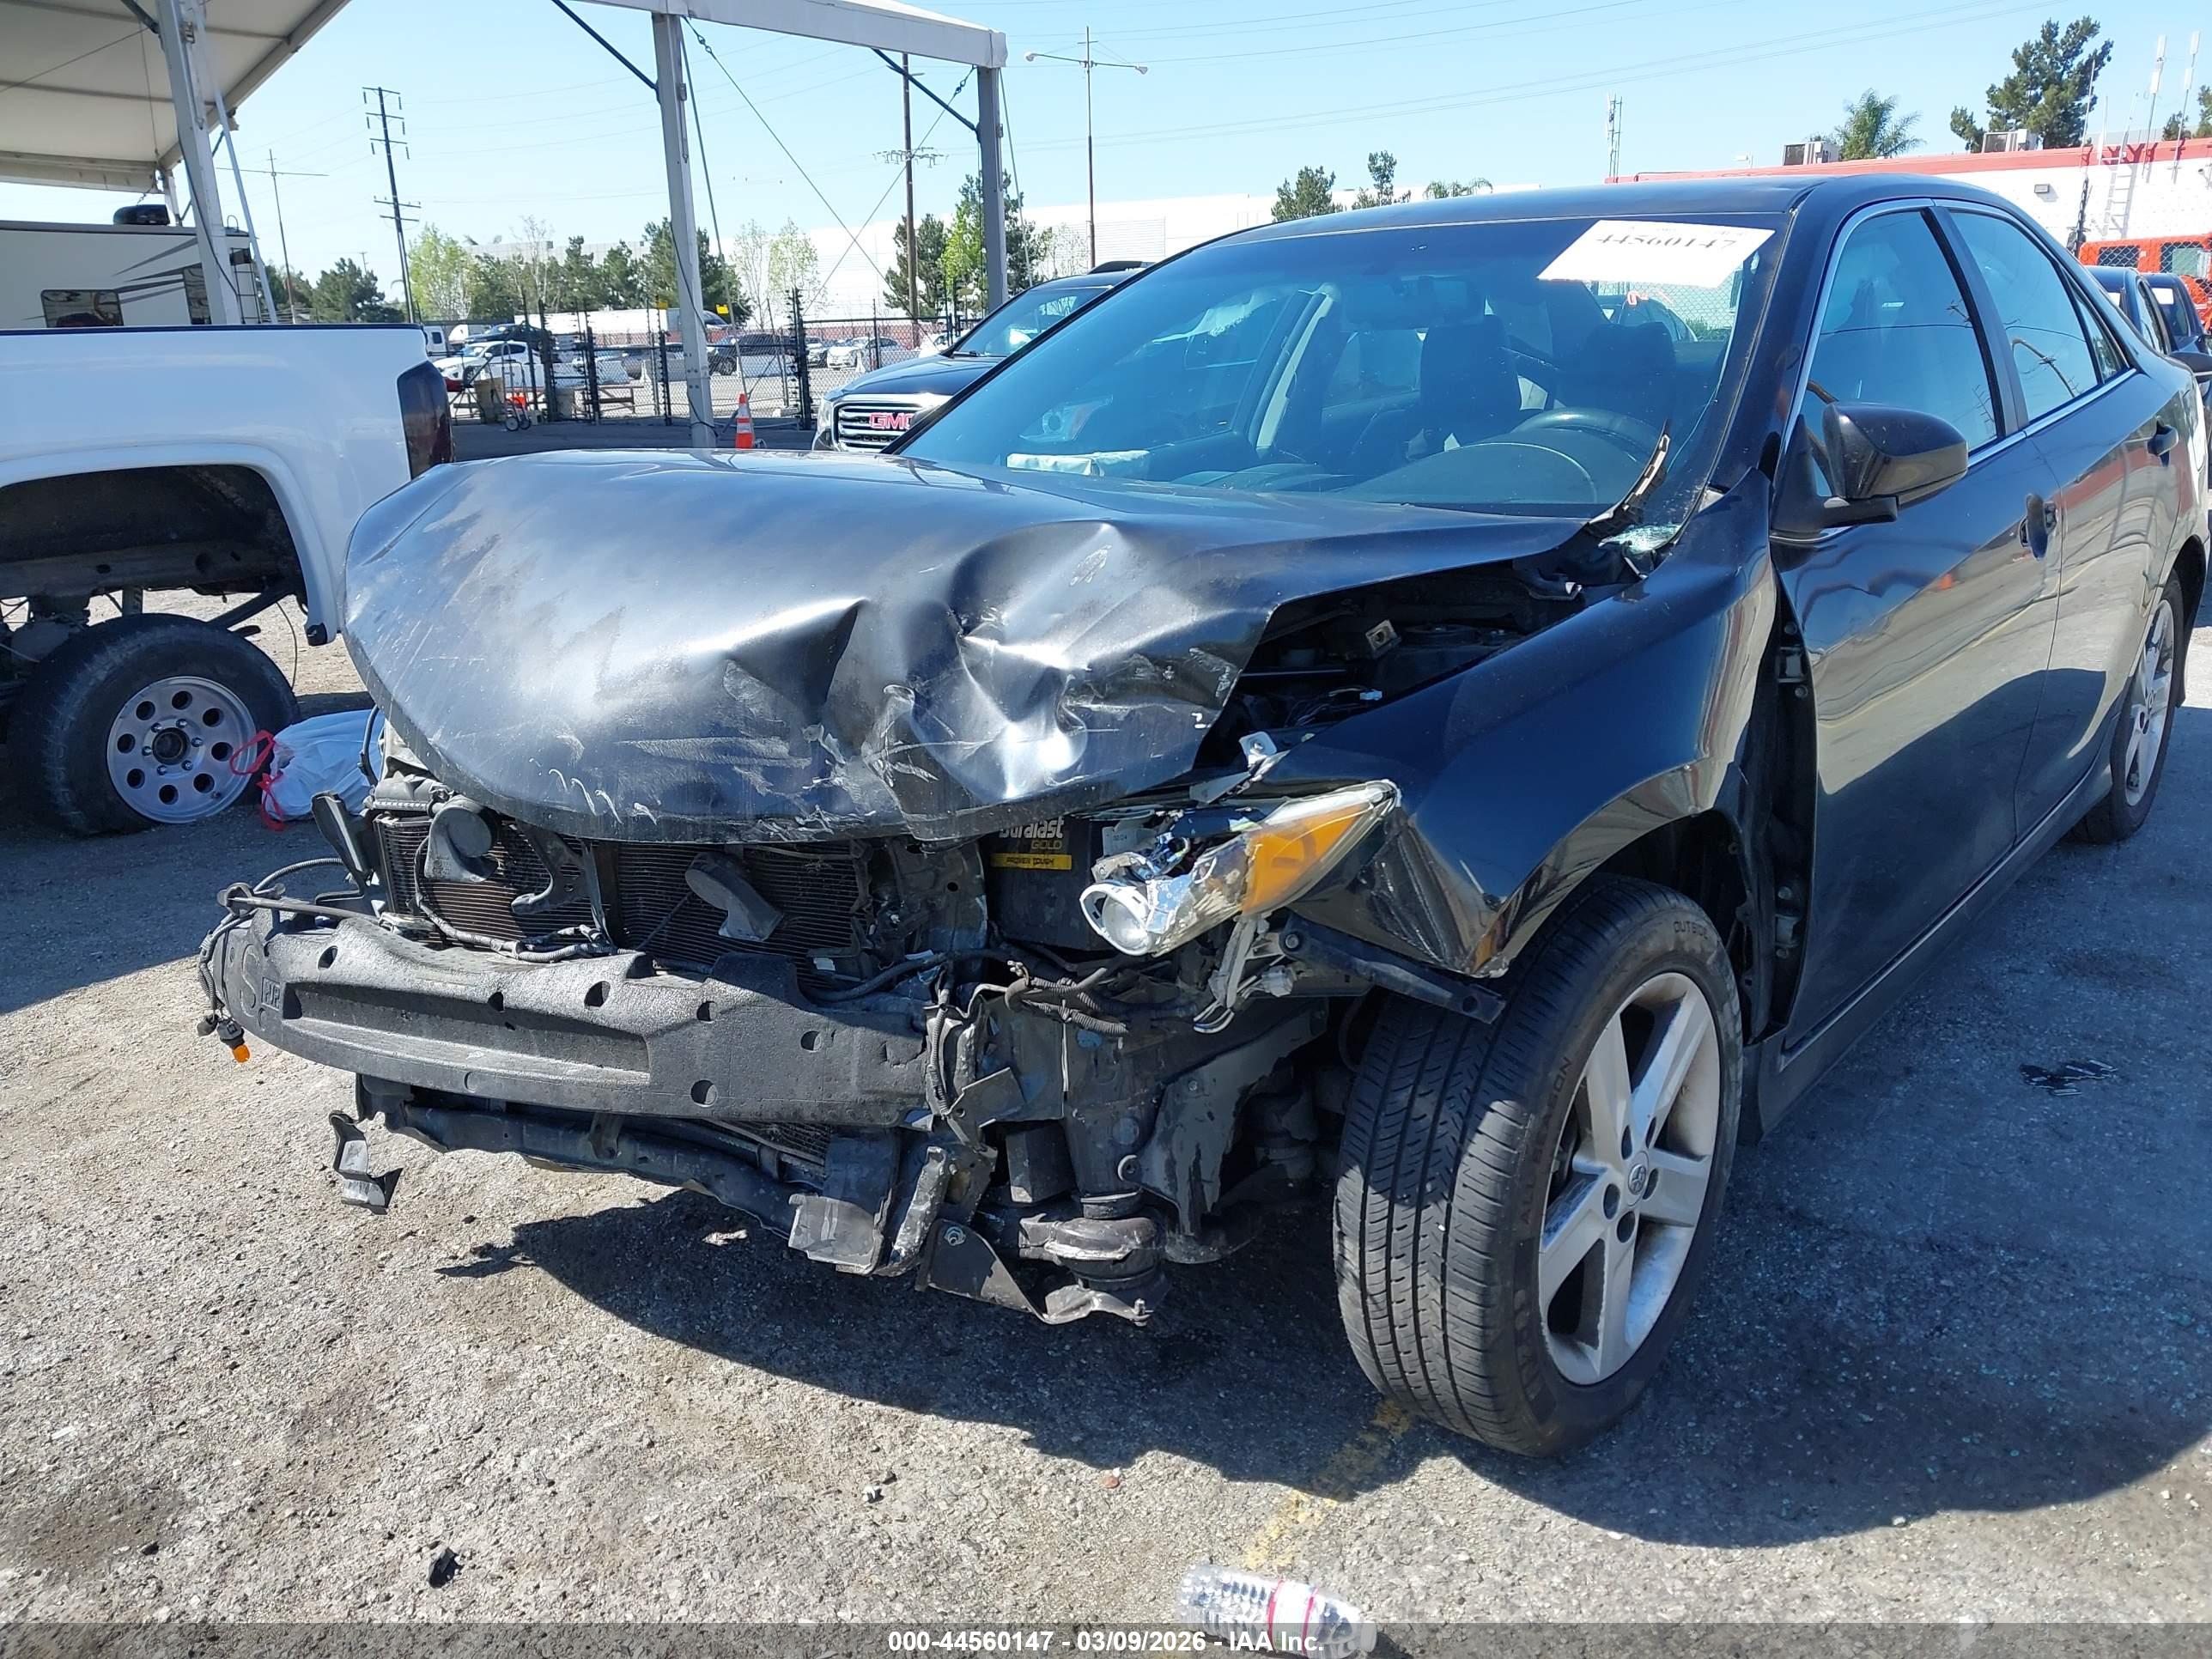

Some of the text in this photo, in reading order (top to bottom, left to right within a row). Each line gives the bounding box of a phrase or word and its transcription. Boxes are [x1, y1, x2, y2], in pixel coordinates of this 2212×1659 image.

[1596, 234, 1736, 249] 44560147
[869, 412, 914, 429] GMC
[1030, 840, 1062, 850] GOLD
